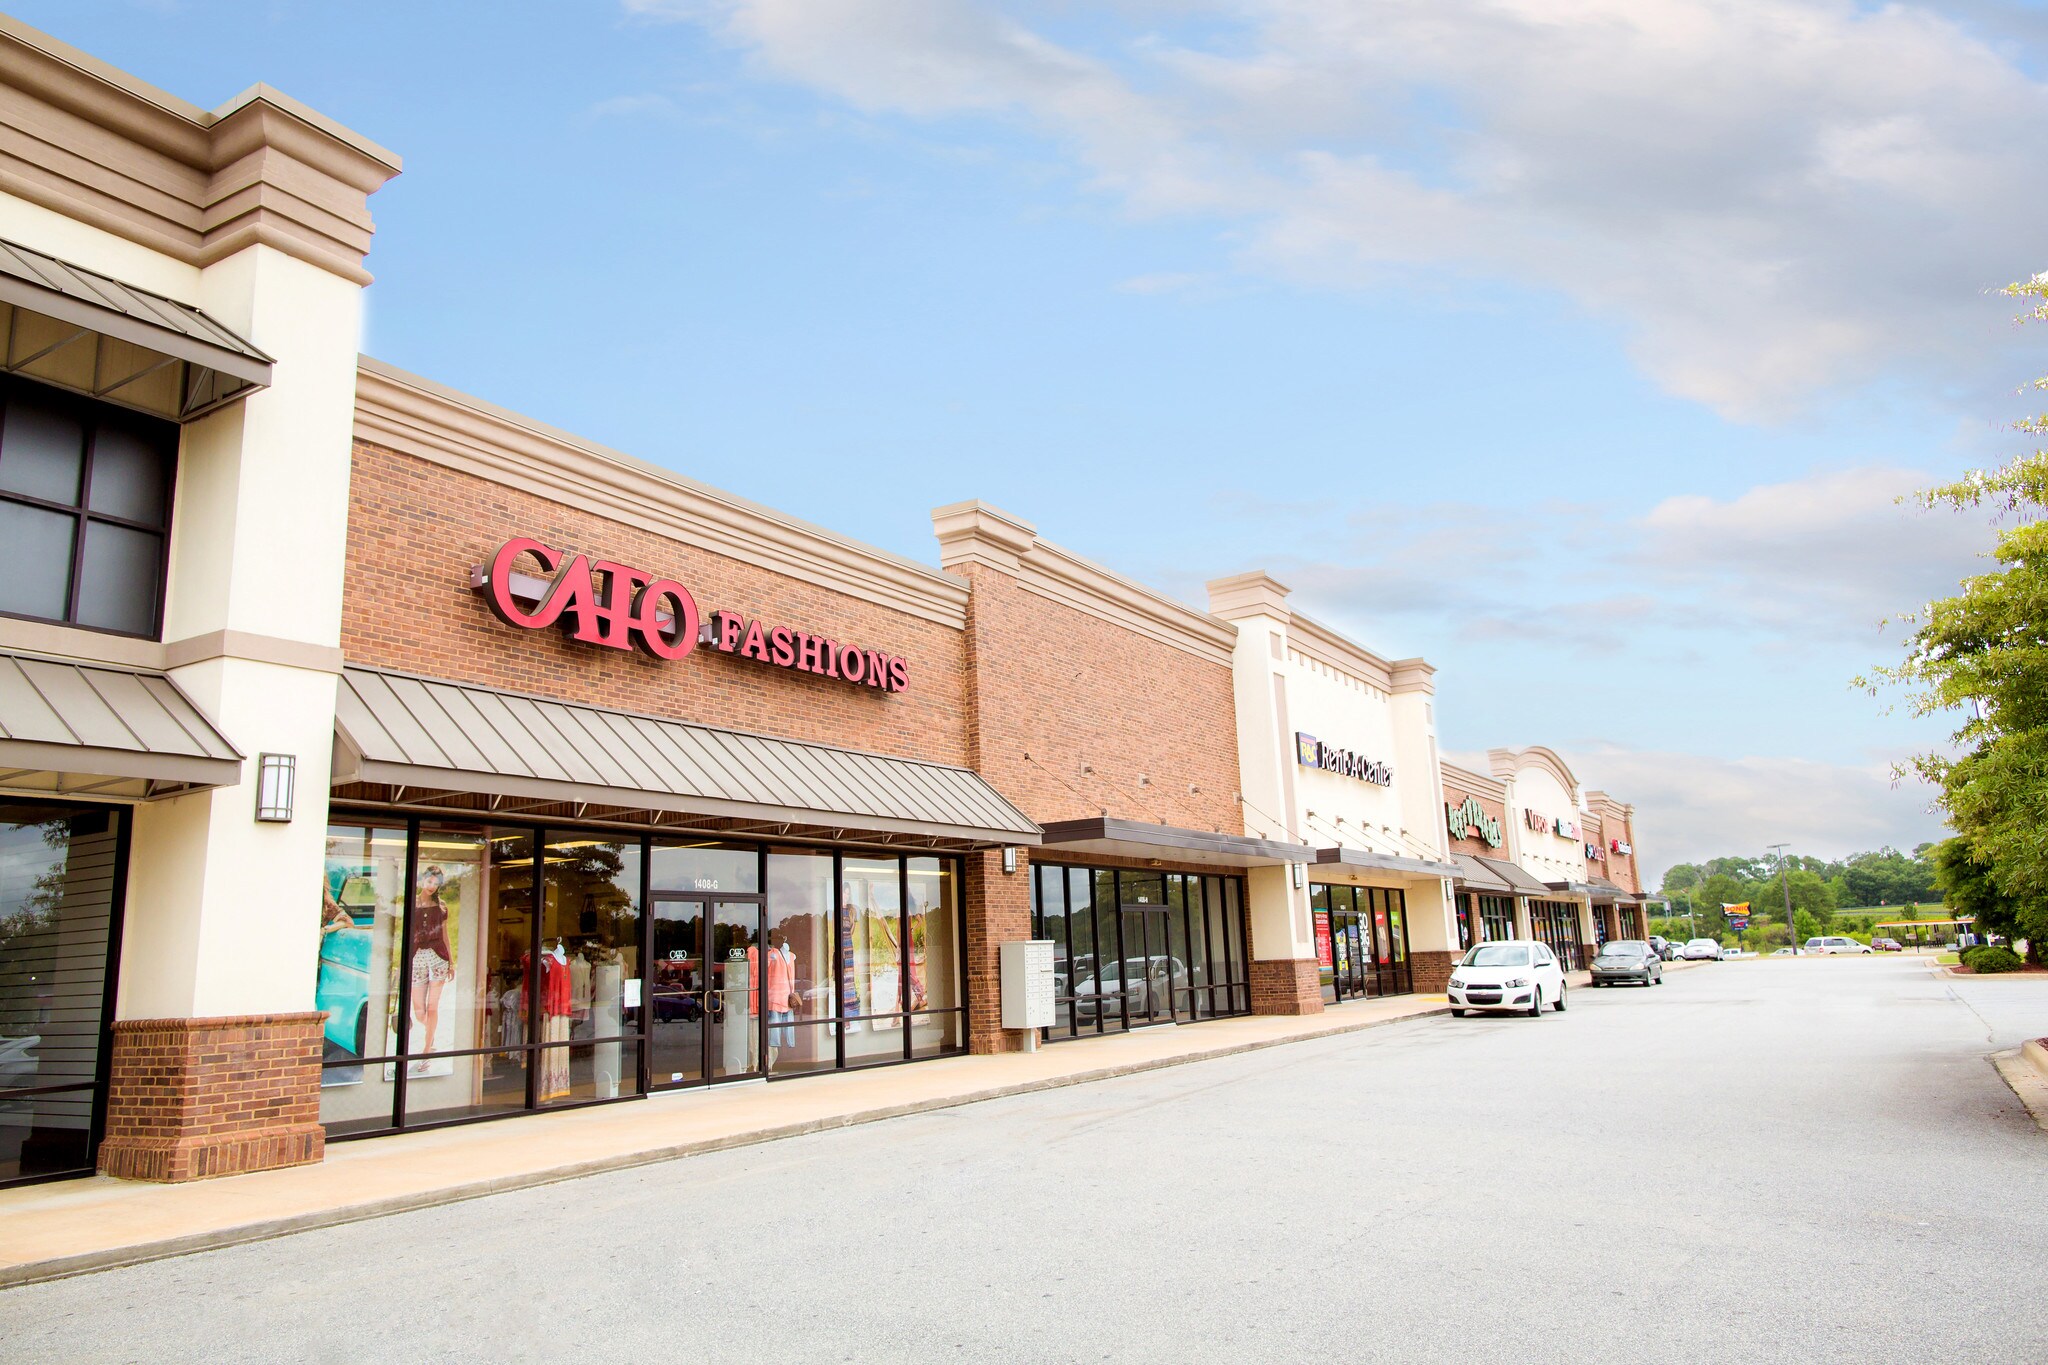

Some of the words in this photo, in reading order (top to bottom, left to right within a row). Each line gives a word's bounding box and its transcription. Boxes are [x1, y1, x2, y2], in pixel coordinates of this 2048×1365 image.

[484, 537, 700, 661] CATO
[710, 609, 909, 693] FASHIONS
[694, 879, 718, 889] 1408-G
